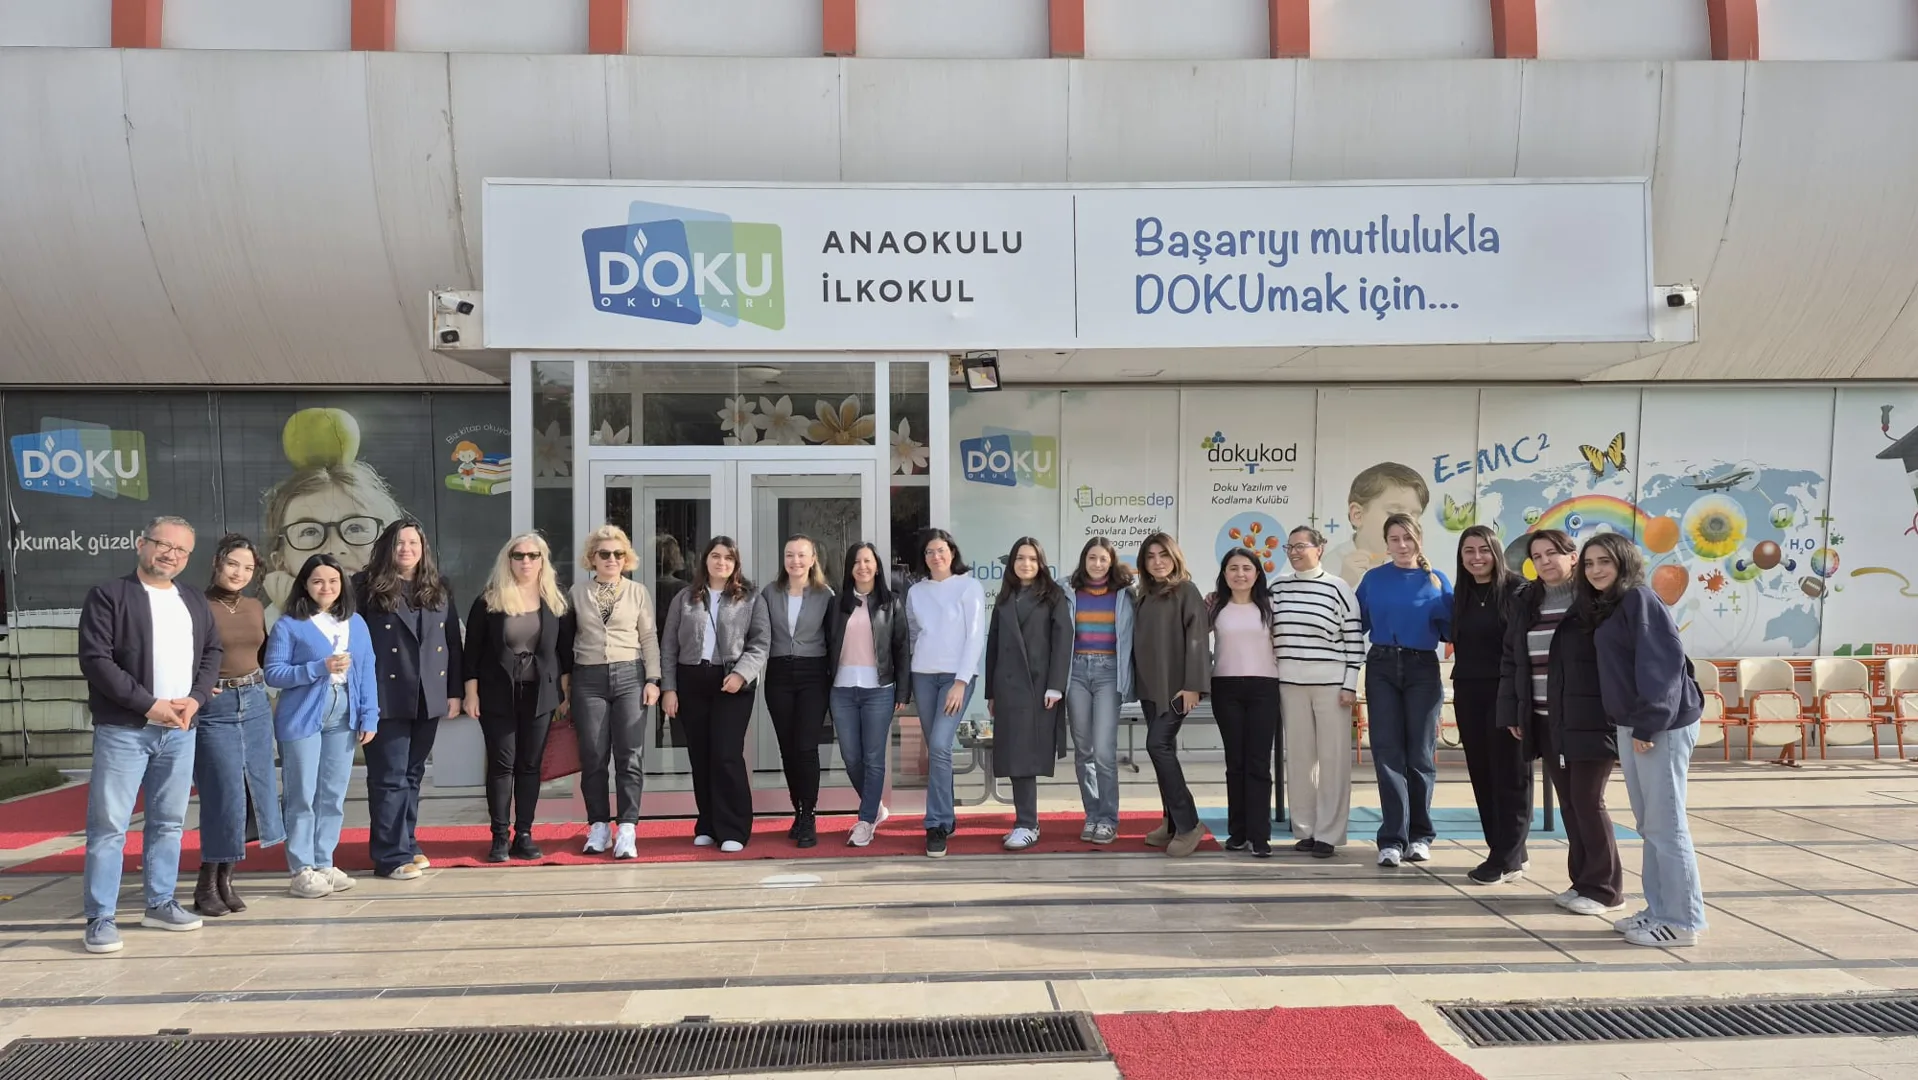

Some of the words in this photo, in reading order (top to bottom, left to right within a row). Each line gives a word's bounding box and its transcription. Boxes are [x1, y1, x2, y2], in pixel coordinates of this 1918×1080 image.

[821, 230, 1022, 254] ANAOKULU
[1134, 216, 1299, 268] Başarıyı
[1310, 212, 1500, 255] mutlulukla
[599, 251, 773, 296] DOKU
[822, 272, 974, 303] İLKOKUL
[1135, 271, 1350, 315] DOKUmak
[1359, 276, 1459, 321] için...
[601, 297, 772, 308] OKULLARI
[445, 432, 460, 445] Biz
[458, 424, 482, 435] kitap
[967, 450, 1052, 473] DOKU
[1207, 442, 1297, 462] dokukod
[22, 449, 140, 479] DOKU
[1213, 482, 1239, 492] Doku
[1241, 482, 1273, 492] Yazılım
[1094, 492, 1174, 509] domesdep
[1211, 495, 1253, 504] Kodlama
[1255, 495, 1289, 504] Kulübü
[1091, 514, 1116, 524] Doku
[1118, 514, 1157, 524] Merkezi
[1085, 526, 1127, 535] Sınavlara
